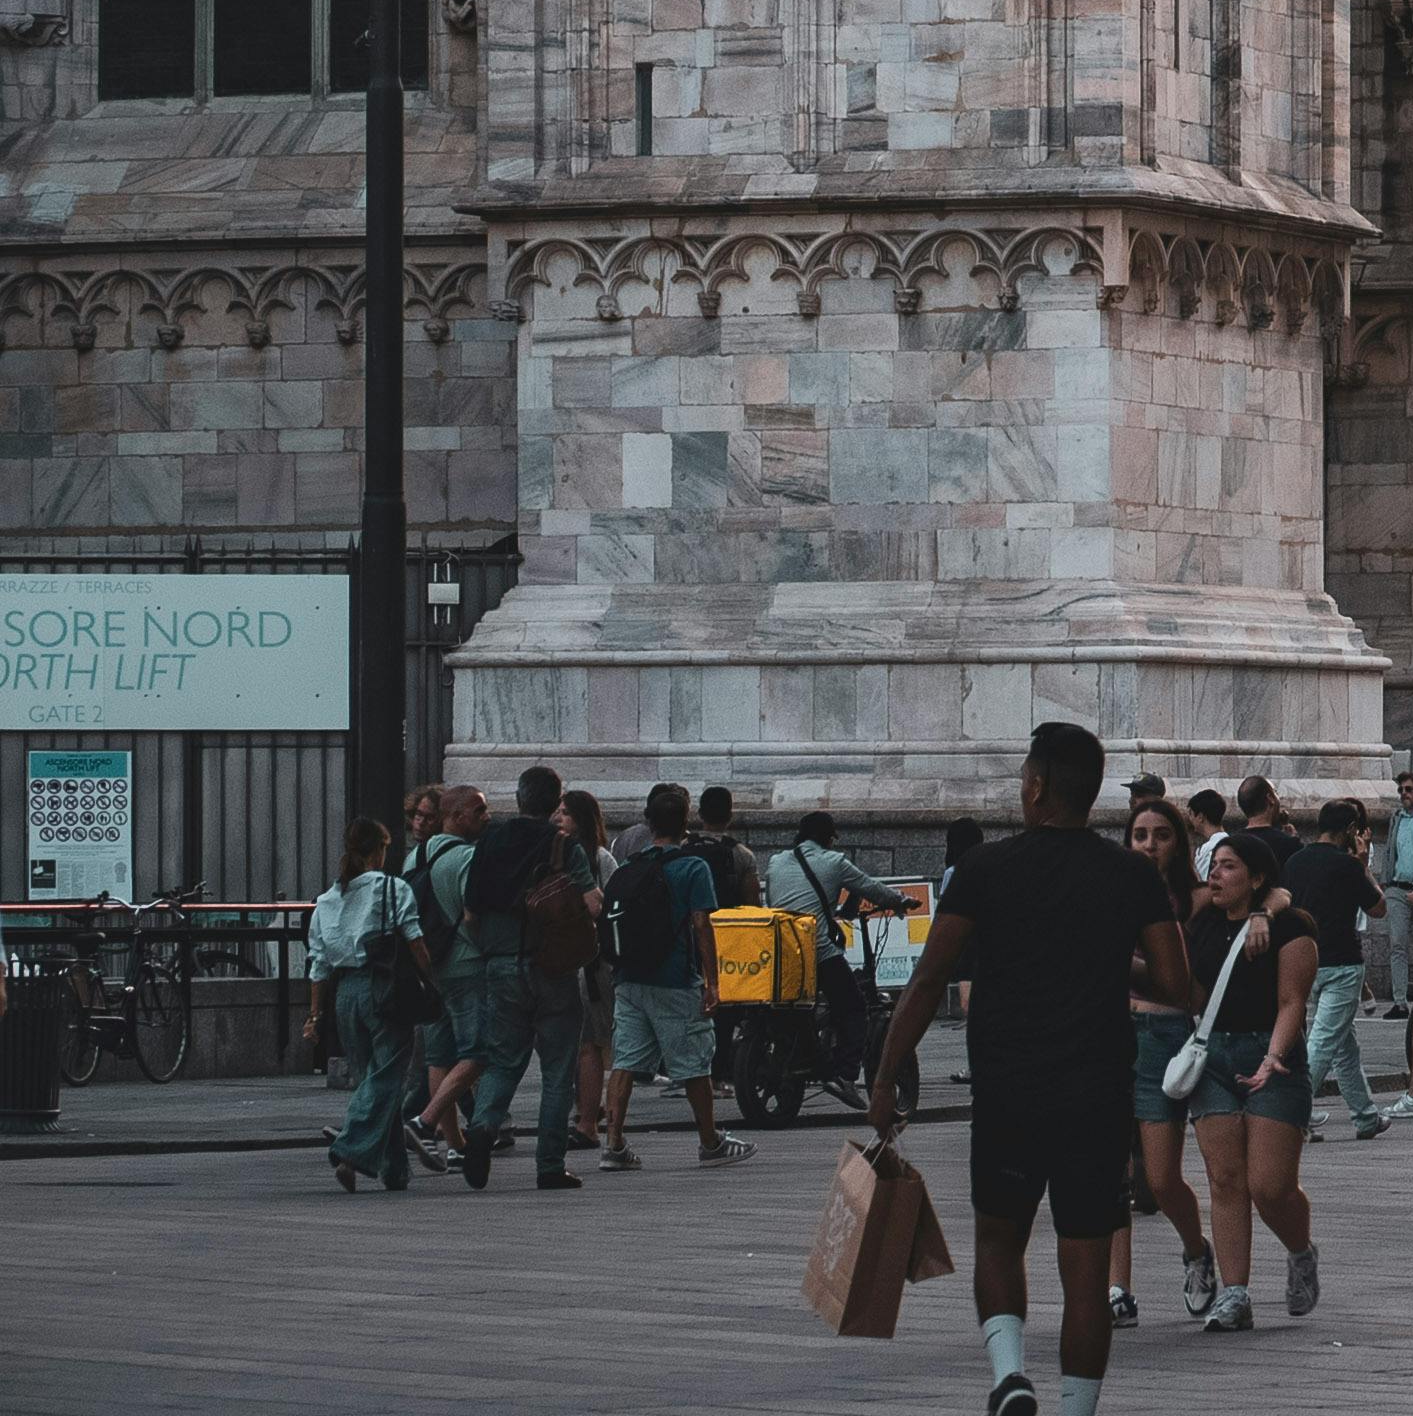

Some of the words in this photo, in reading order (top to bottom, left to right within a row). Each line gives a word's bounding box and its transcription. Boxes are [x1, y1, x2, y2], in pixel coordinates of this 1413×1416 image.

[75, 580, 152, 594] TERRACES
[4, 610, 126, 648] SORE
[144, 610, 292, 648] NORD
[115, 653, 196, 690] LIFT
[28, 705, 86, 723] GATE
[93, 705, 103, 723] 2
